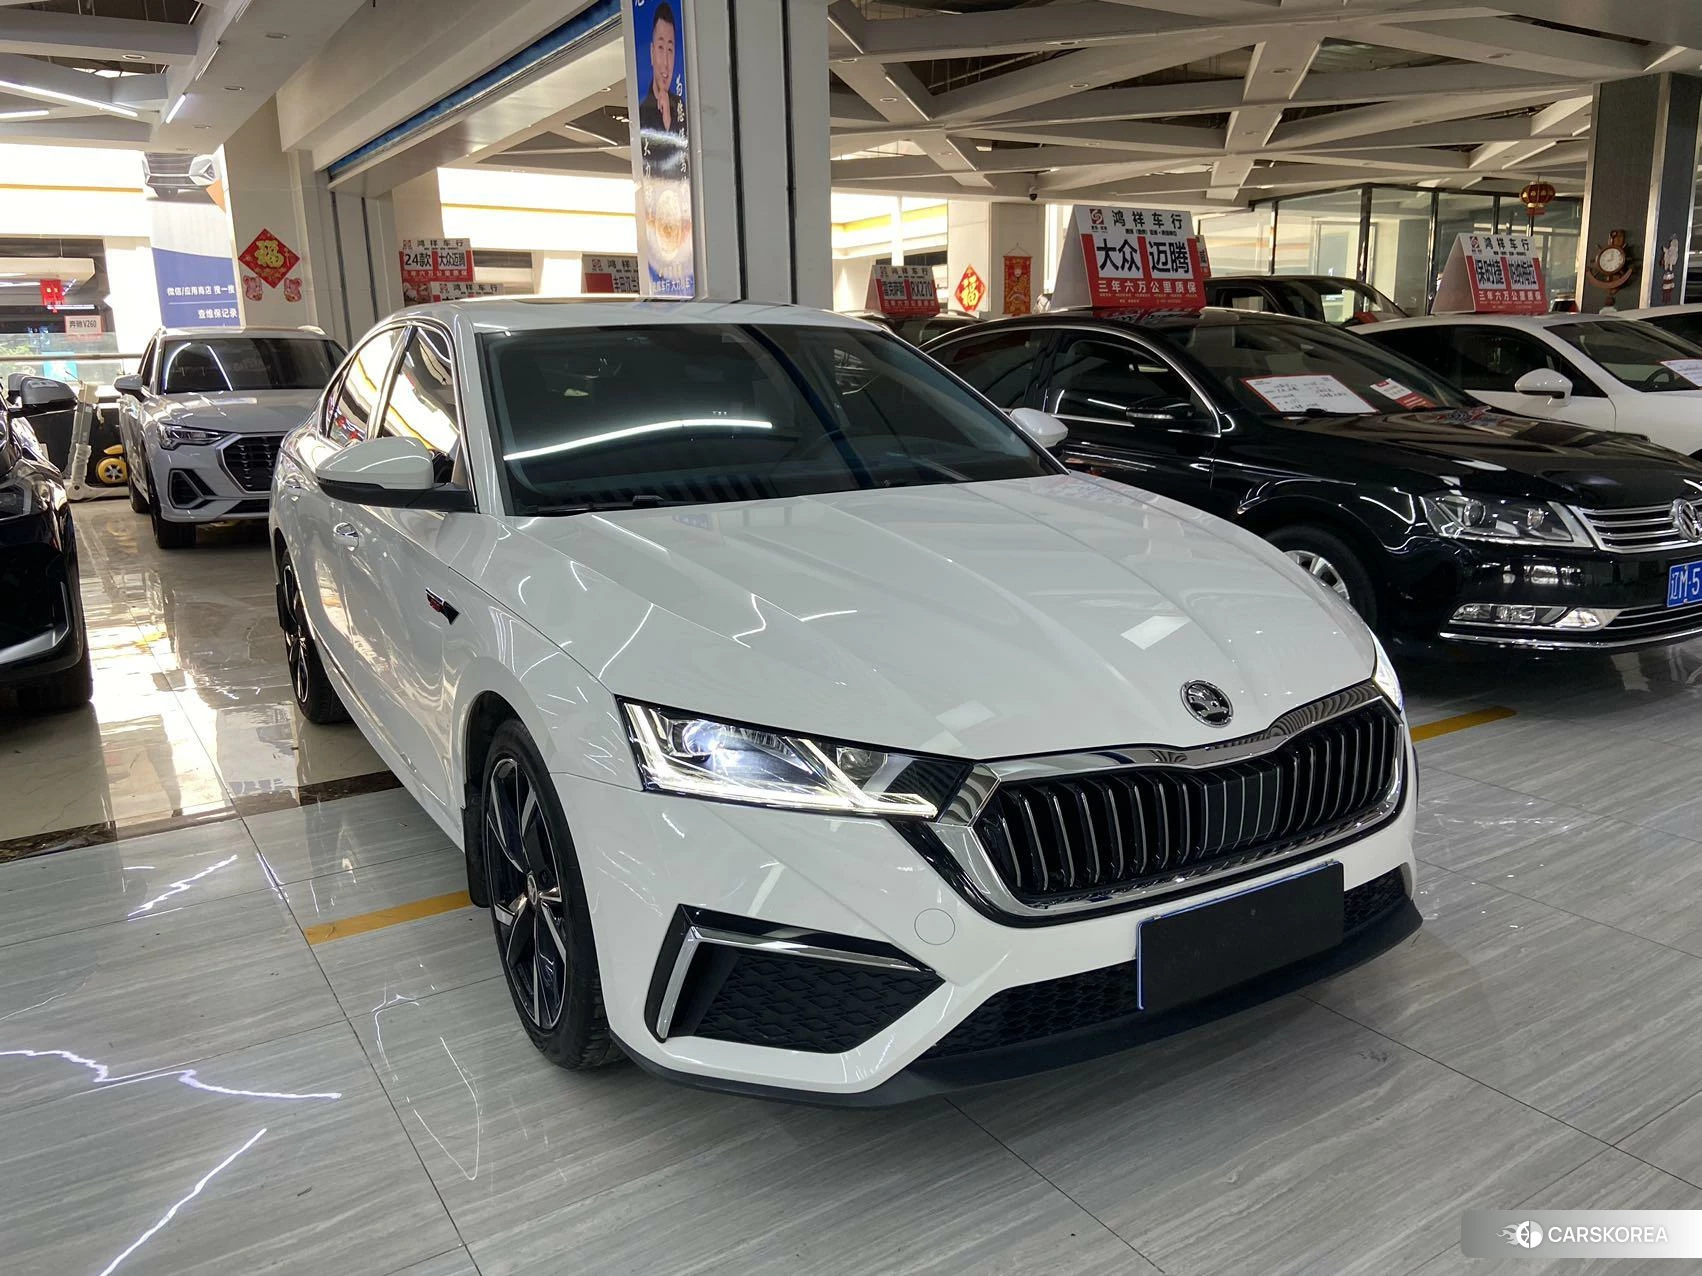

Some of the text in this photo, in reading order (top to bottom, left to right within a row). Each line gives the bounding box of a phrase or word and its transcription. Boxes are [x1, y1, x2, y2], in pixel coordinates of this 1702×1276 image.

[1112, 209, 1182, 230] 鸿祥车行
[1483, 236, 1530, 252] 鸿祥车行
[255, 240, 285, 268] 福
[405, 252, 466, 267] 24款 大众迈腾
[1096, 238, 1190, 273] 大众 迈腾
[1476, 259, 1504, 285] 保时捷
[910, 281, 933, 297] RX270
[961, 274, 979, 307] 福
[1098, 280, 1197, 293] 三年六万公里质保
[1479, 290, 1542, 300] 三年六万公里质保
